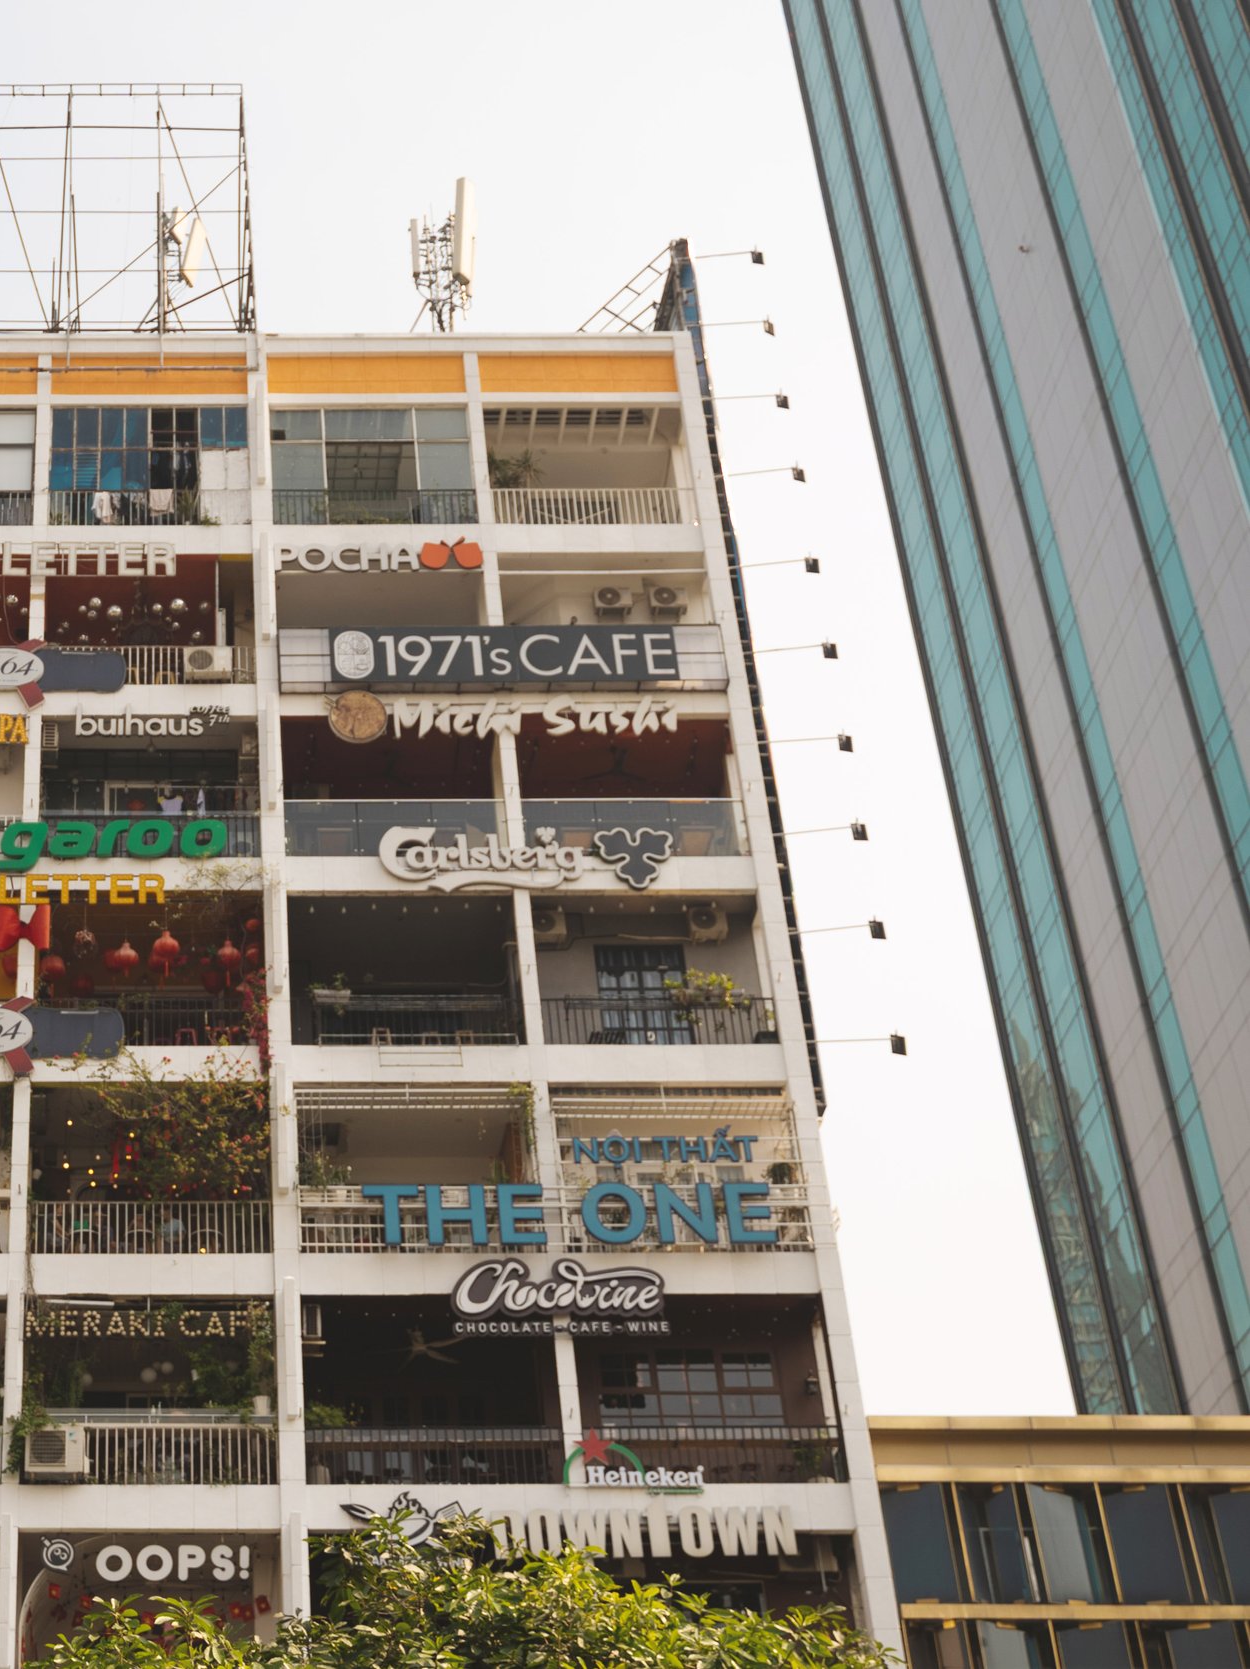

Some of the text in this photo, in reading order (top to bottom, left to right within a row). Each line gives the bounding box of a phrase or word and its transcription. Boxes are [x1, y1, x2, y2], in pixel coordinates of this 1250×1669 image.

[2, 540, 177, 577] LETTER
[275, 543, 421, 572] POCHA
[377, 633, 676, 676] 1971's CAFE
[189, 705, 230, 715] coffee
[393, 695, 678, 739] Michi Sushi
[379, 826, 586, 882] Carlsberg
[651, 1124, 759, 1163] THẤT
[361, 1181, 780, 1247] THE ONE
[25, 1309, 166, 1338] MERAKI
[454, 1321, 670, 1334] CHOCOLATE CAFE WINE
[586, 1465, 705, 1487] Heineken
[490, 1505, 799, 1560] DOWNTOWN
[95, 1544, 251, 1583] OOPS!
